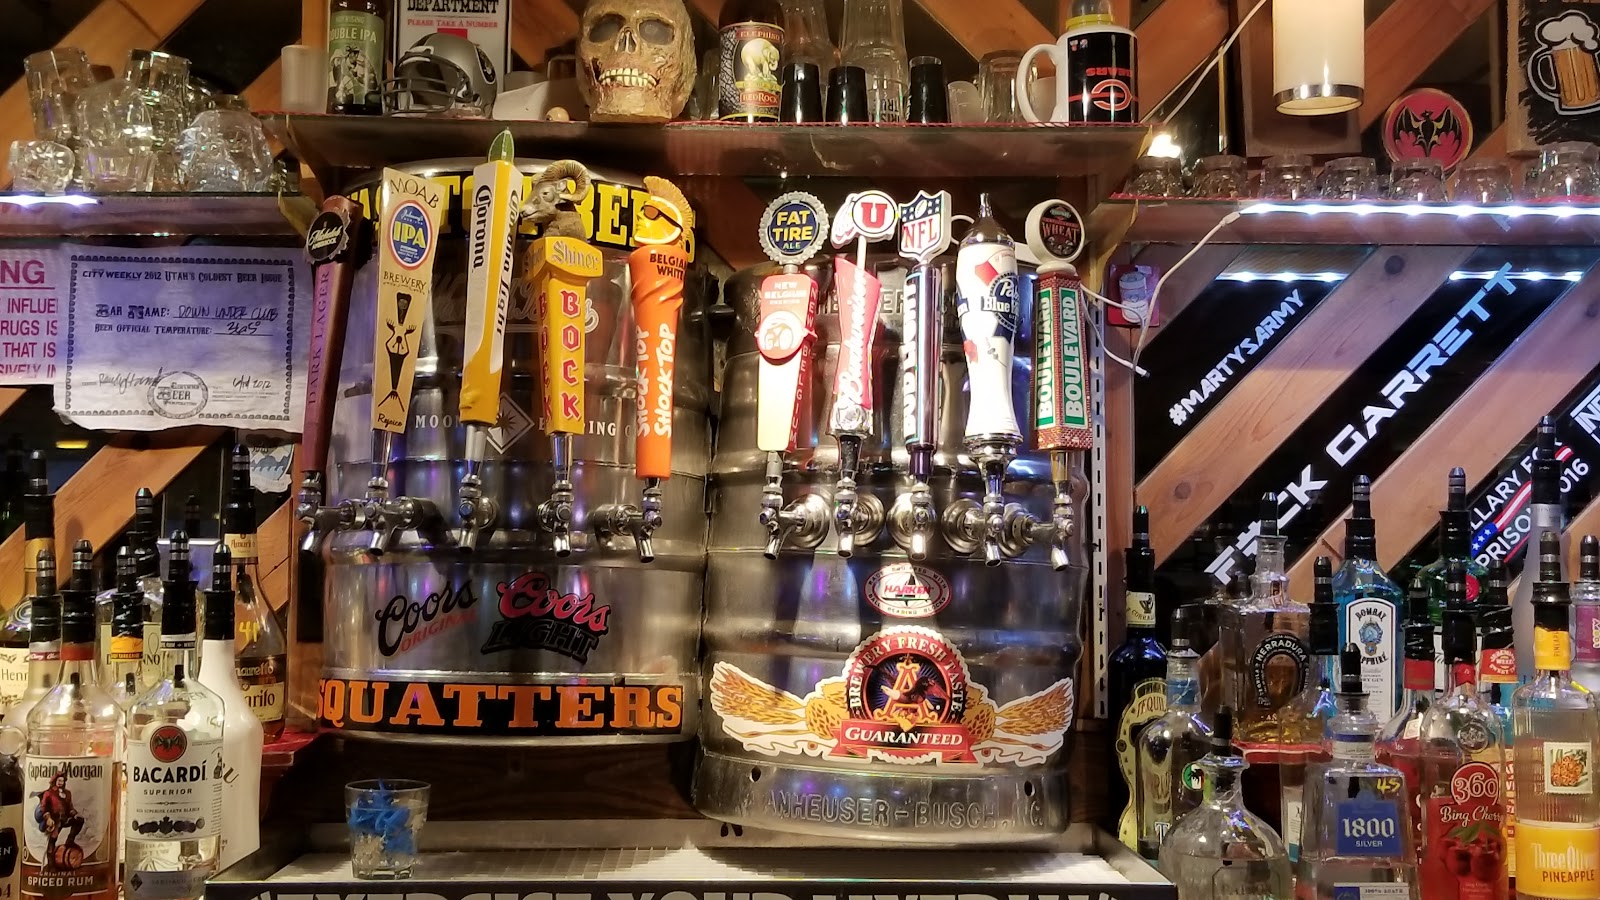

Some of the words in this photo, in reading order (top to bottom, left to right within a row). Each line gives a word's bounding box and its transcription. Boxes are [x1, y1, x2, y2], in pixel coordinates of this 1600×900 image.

[407, 0, 499, 13] DEPARTMENT
[330, 27, 358, 40] OUBLE
[360, 29, 377, 43] IPA
[467, 20, 498, 28] NUMBER
[390, 177, 440, 209] MOAB
[473, 184, 493, 270] Corona
[777, 210, 811, 226] FAT
[861, 202, 888, 228] U
[393, 221, 427, 249] IPA
[772, 226, 813, 242] TIRE
[902, 218, 938, 249] NFL
[1042, 221, 1080, 244] WHEAT
[552, 239, 599, 270] Shiner
[783, 242, 801, 250] ALE
[82, 270, 103, 278] CITY
[106, 270, 143, 280] WEEKLY
[144, 271, 162, 280] 2012
[165, 271, 195, 281] UTAH'S
[198, 272, 233, 283] COLDEST
[237, 273, 257, 283] BEER
[260, 273, 282, 283] ISSUE
[383, 270, 427, 290] BREWERY
[7, 298, 59, 314] INFLUE
[95, 304, 122, 318] BAR
[178, 305, 210, 318] DOWN
[215, 306, 247, 318] UNDER
[250, 307, 279, 322] CLUB
[314, 271, 330, 339] LAGER
[806, 287, 817, 328] NEW
[982, 295, 1011, 313] Blue
[94, 323, 113, 333] BEER
[116, 324, 151, 334] OFFICIAL
[154, 325, 213, 335] TEMPERATURE:
[3, 342, 37, 358] THAT
[43, 342, 56, 358] IS
[560, 290, 582, 421] BOCK
[656, 322, 676, 369] TOP
[1037, 296, 1053, 418] BOULEVARD
[1062, 296, 1084, 418] BOULEVARD
[1168, 288, 1305, 427] #MARTYSARMY
[308, 347, 322, 404] DARK
[1325, 262, 1518, 468] GARRETT
[654, 368, 674, 439] SHOCK
[789, 344, 808, 448] BELGIUM
[1474, 507, 1532, 571] PRISO
[495, 570, 612, 633] Coors
[884, 584, 931, 595] HARKEN
[375, 578, 479, 657] Coors
[1355, 607, 1387, 622] BOMBAY
[400, 610, 478, 653] ORIGINAL
[480, 617, 600, 664] LIGHT
[1255, 639, 1307, 662] HERRADURA
[848, 637, 892, 709] BREWERY
[897, 636, 948, 662] FRESH
[943, 660, 964, 712] TASTE
[316, 677, 684, 731] SQUATTERS
[845, 727, 963, 746] GUARANTEED
[28, 761, 58, 781] Captain
[59, 760, 103, 782] Morgan
[133, 759, 206, 784] BACARDÍ
[143, 788, 193, 796] SUPERIOR
[1454, 771, 1498, 803] 360
[1341, 817, 1395, 839] 1800
[1440, 805, 1470, 828] Bing
[1355, 840, 1383, 848] SILVER
[1531, 842, 1566, 870] Three
[1567, 841, 1595, 872] Oliv
[27, 876, 63, 887] SPICED
[67, 875, 94, 886] RUM
[1542, 869, 1595, 883] PINEAPPLE
